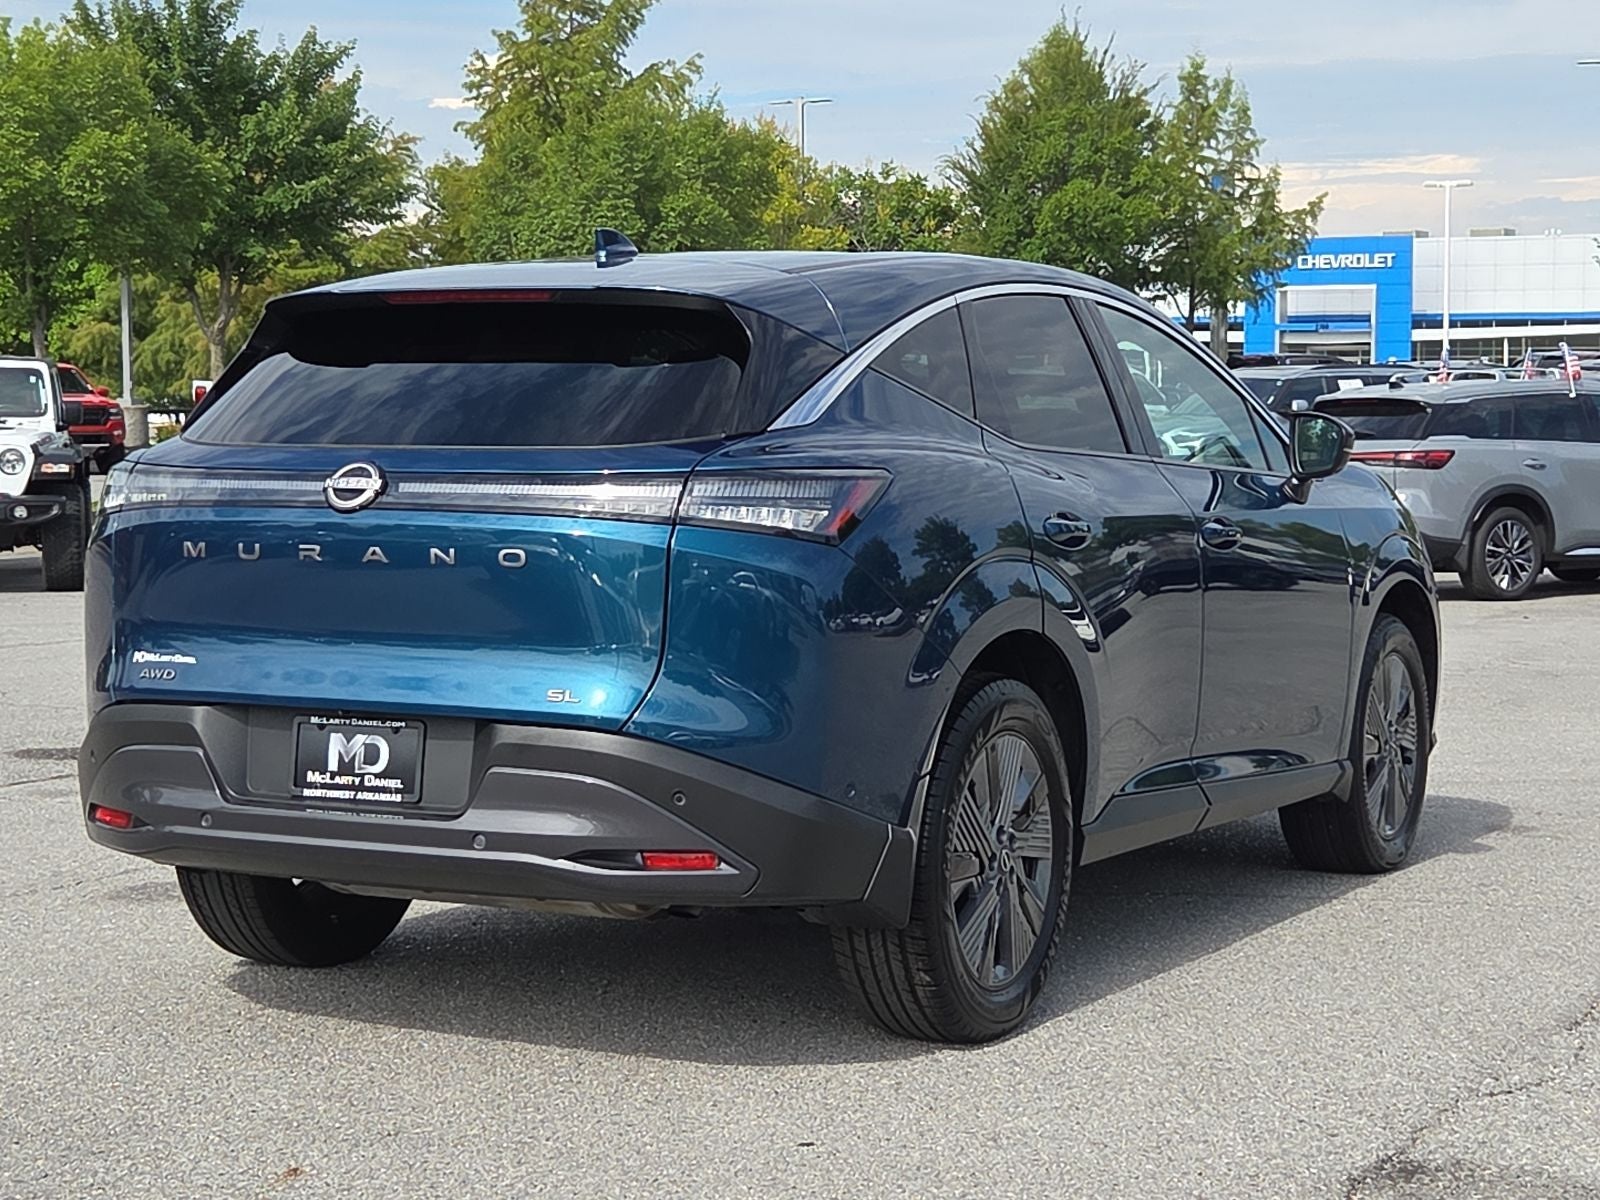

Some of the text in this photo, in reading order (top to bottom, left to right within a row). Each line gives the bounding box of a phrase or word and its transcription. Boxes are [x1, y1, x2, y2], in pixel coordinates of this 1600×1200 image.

[1297, 253, 1396, 269] CHEVROLET
[325, 477, 382, 490] NISSAN
[183, 541, 527, 568] MURANO
[139, 668, 176, 680] AWD
[546, 689, 581, 702] SL
[328, 733, 390, 773] MD
